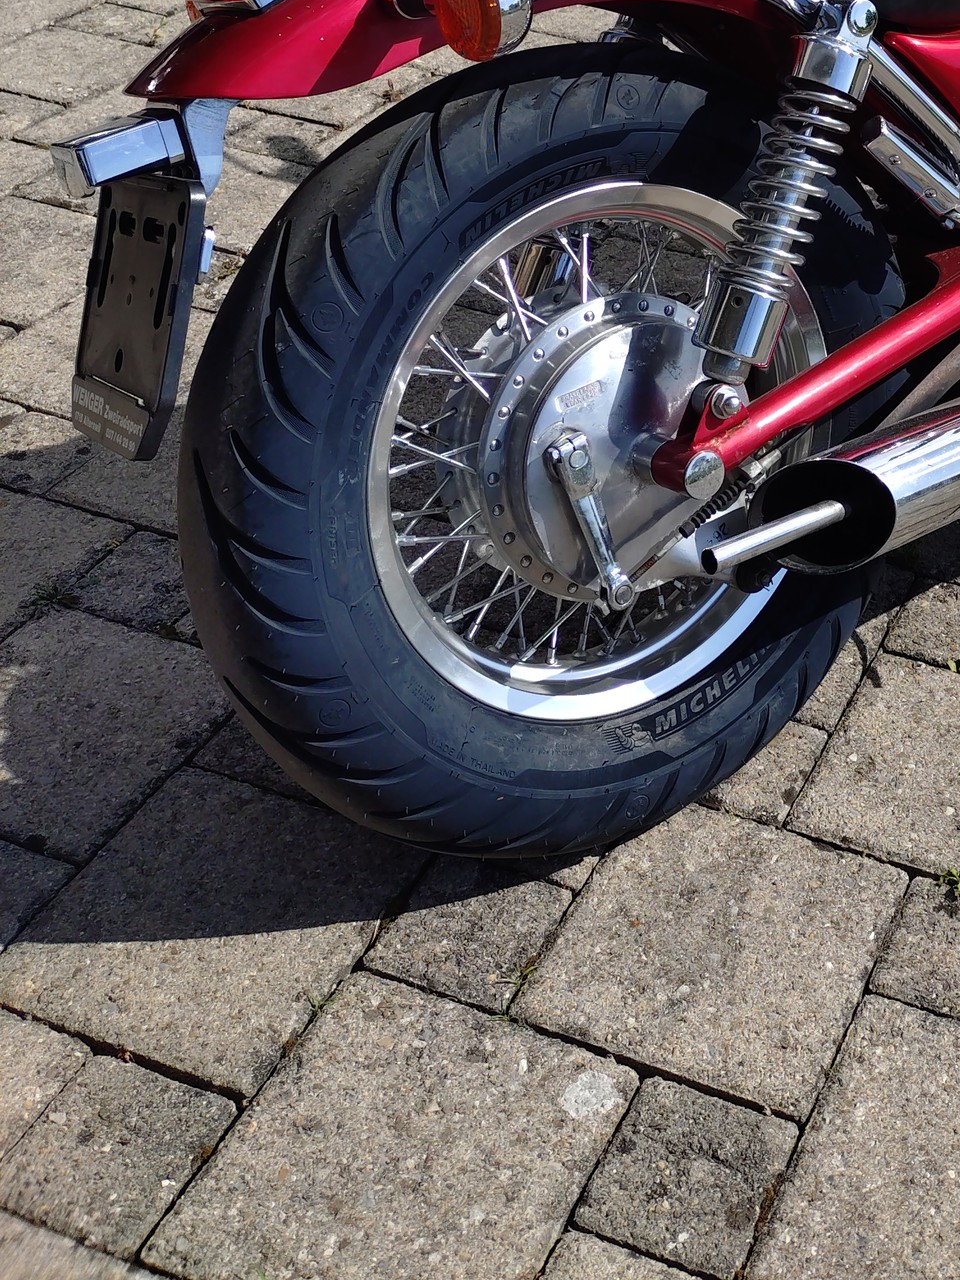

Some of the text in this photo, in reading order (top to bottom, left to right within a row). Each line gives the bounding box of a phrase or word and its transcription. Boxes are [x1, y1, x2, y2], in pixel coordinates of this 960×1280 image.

[463, 159, 607, 249] MICHELIN
[73, 383, 104, 416] WENGER
[430, 737, 517, 780] MADE IN THAILAND
